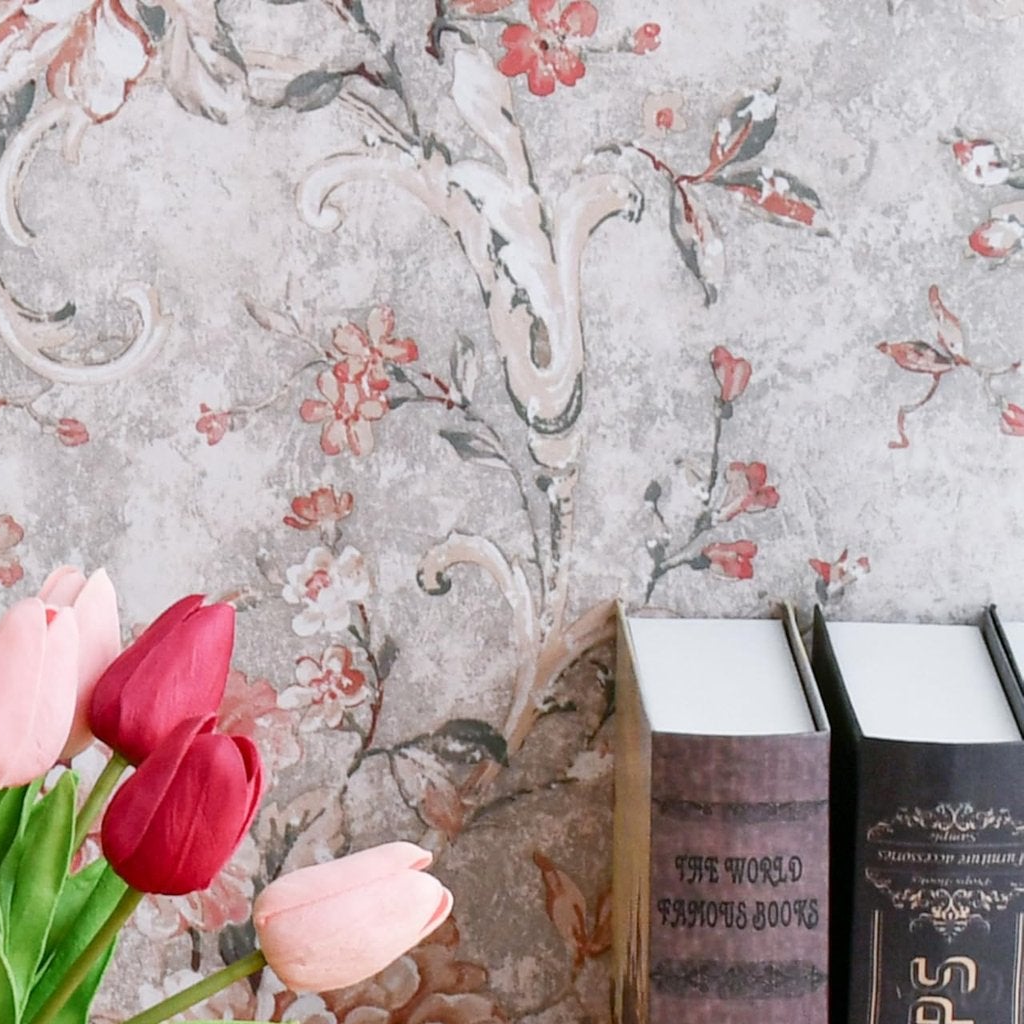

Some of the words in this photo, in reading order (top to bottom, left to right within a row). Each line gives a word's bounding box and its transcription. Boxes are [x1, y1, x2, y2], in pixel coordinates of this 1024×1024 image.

[674, 853, 720, 885] THE
[724, 854, 804, 888] WORLD
[657, 897, 748, 931] FAMOUS
[752, 899, 820, 931] BOOKS
